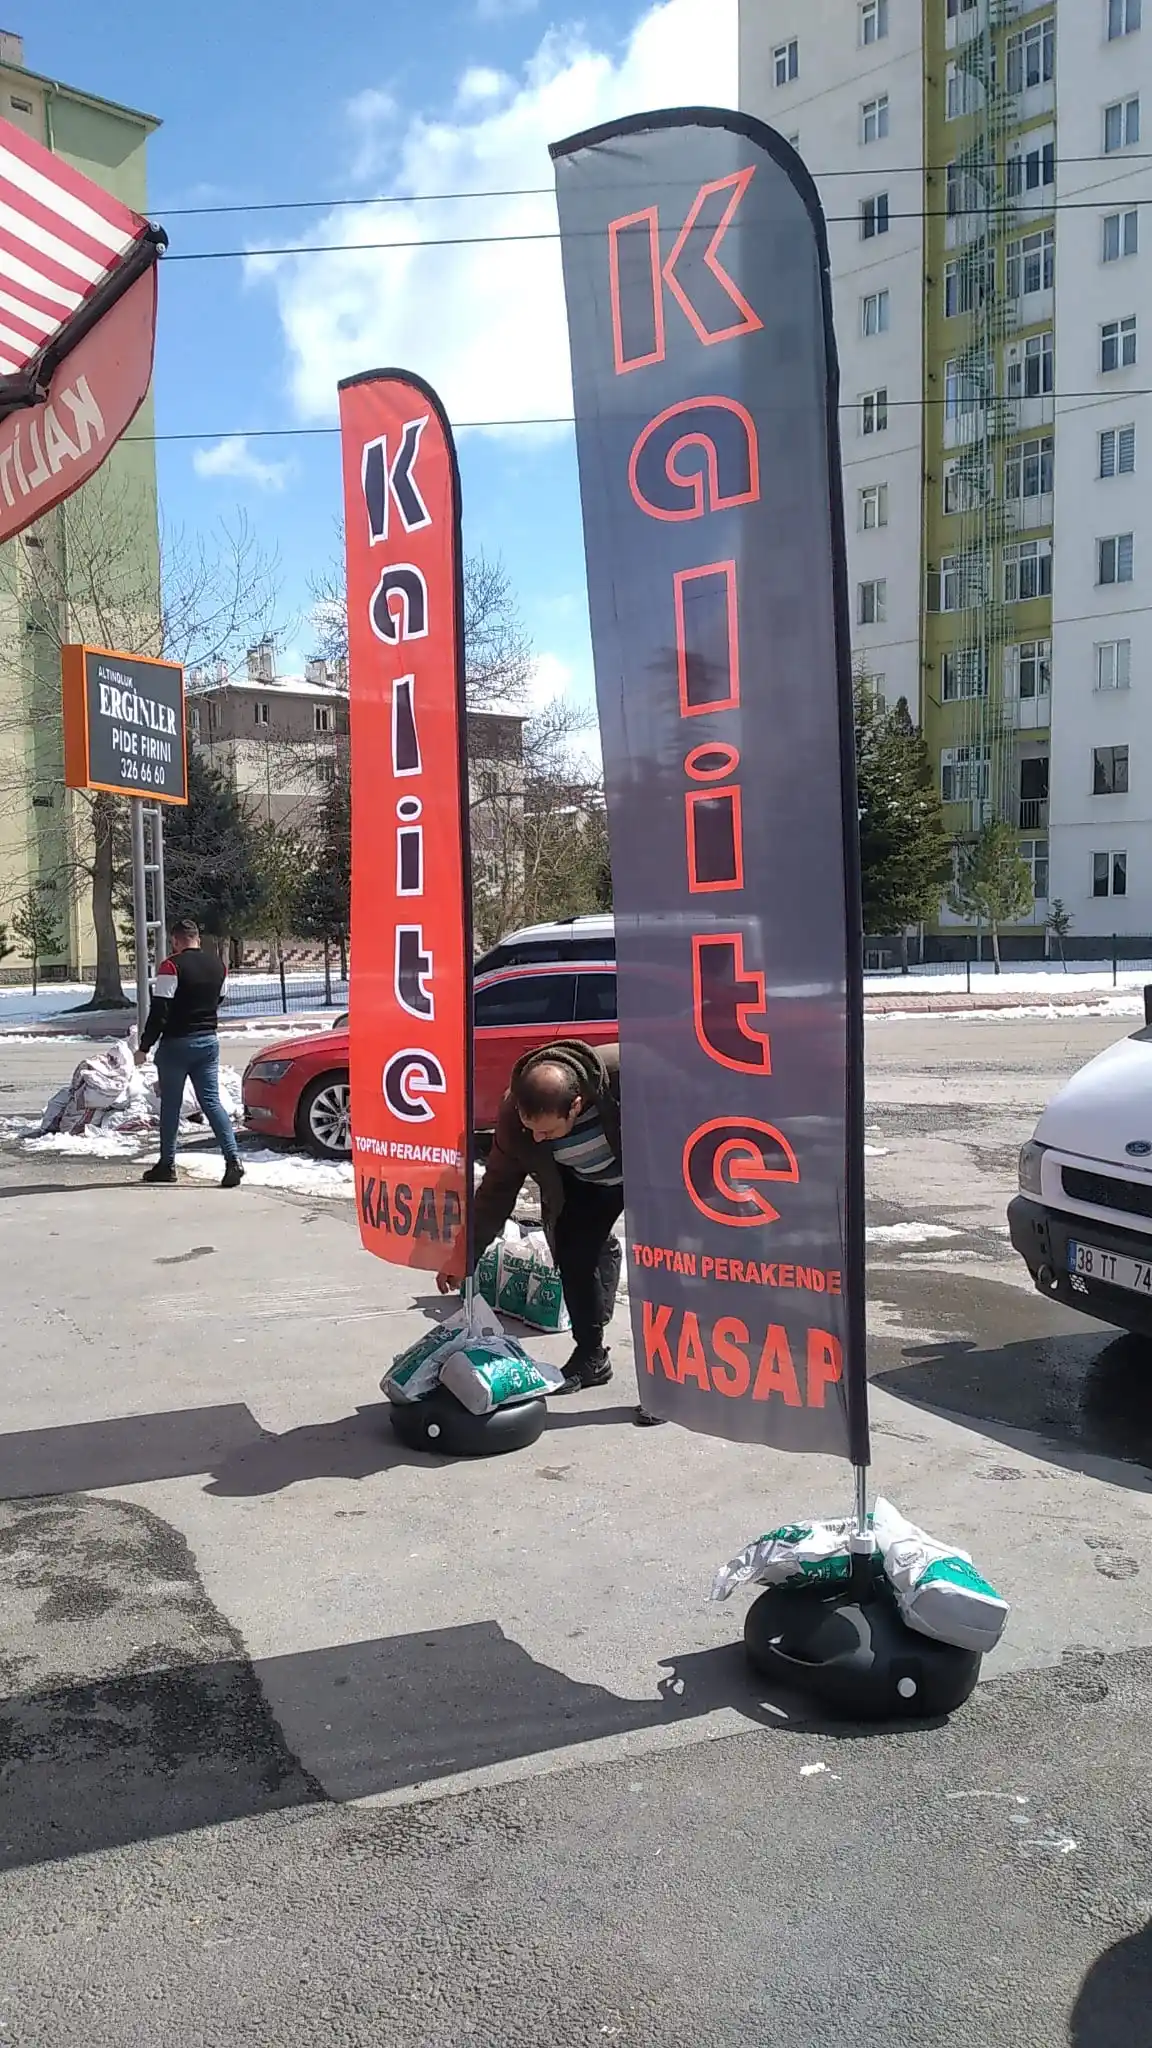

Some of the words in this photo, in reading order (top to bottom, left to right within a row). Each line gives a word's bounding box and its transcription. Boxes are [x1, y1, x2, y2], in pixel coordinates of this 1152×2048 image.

[98, 665, 133, 688] ALTINOLUK
[608, 164, 800, 1228] Kalite
[99, 683, 177, 735] ERGİNLER
[112, 725, 138, 756] PİDE
[141, 735, 171, 763] FIRINI
[361, 414, 447, 1123] Kalite
[120, 757, 138, 780] 326
[140, 762, 152, 783] 66
[154, 765, 165, 785] 60
[355, 1136, 388, 1157] TOPTAN
[390, 1141, 461, 1168] PERAKENDE
[361, 1173, 462, 1244] KASAP
[632, 1243, 697, 1276] TOPTAN
[701, 1256, 842, 1295] PERAKENDE
[1077, 1247, 1094, 1273] 38
[1101, 1254, 1117, 1280] TT
[642, 1300, 843, 1409] KASAP
